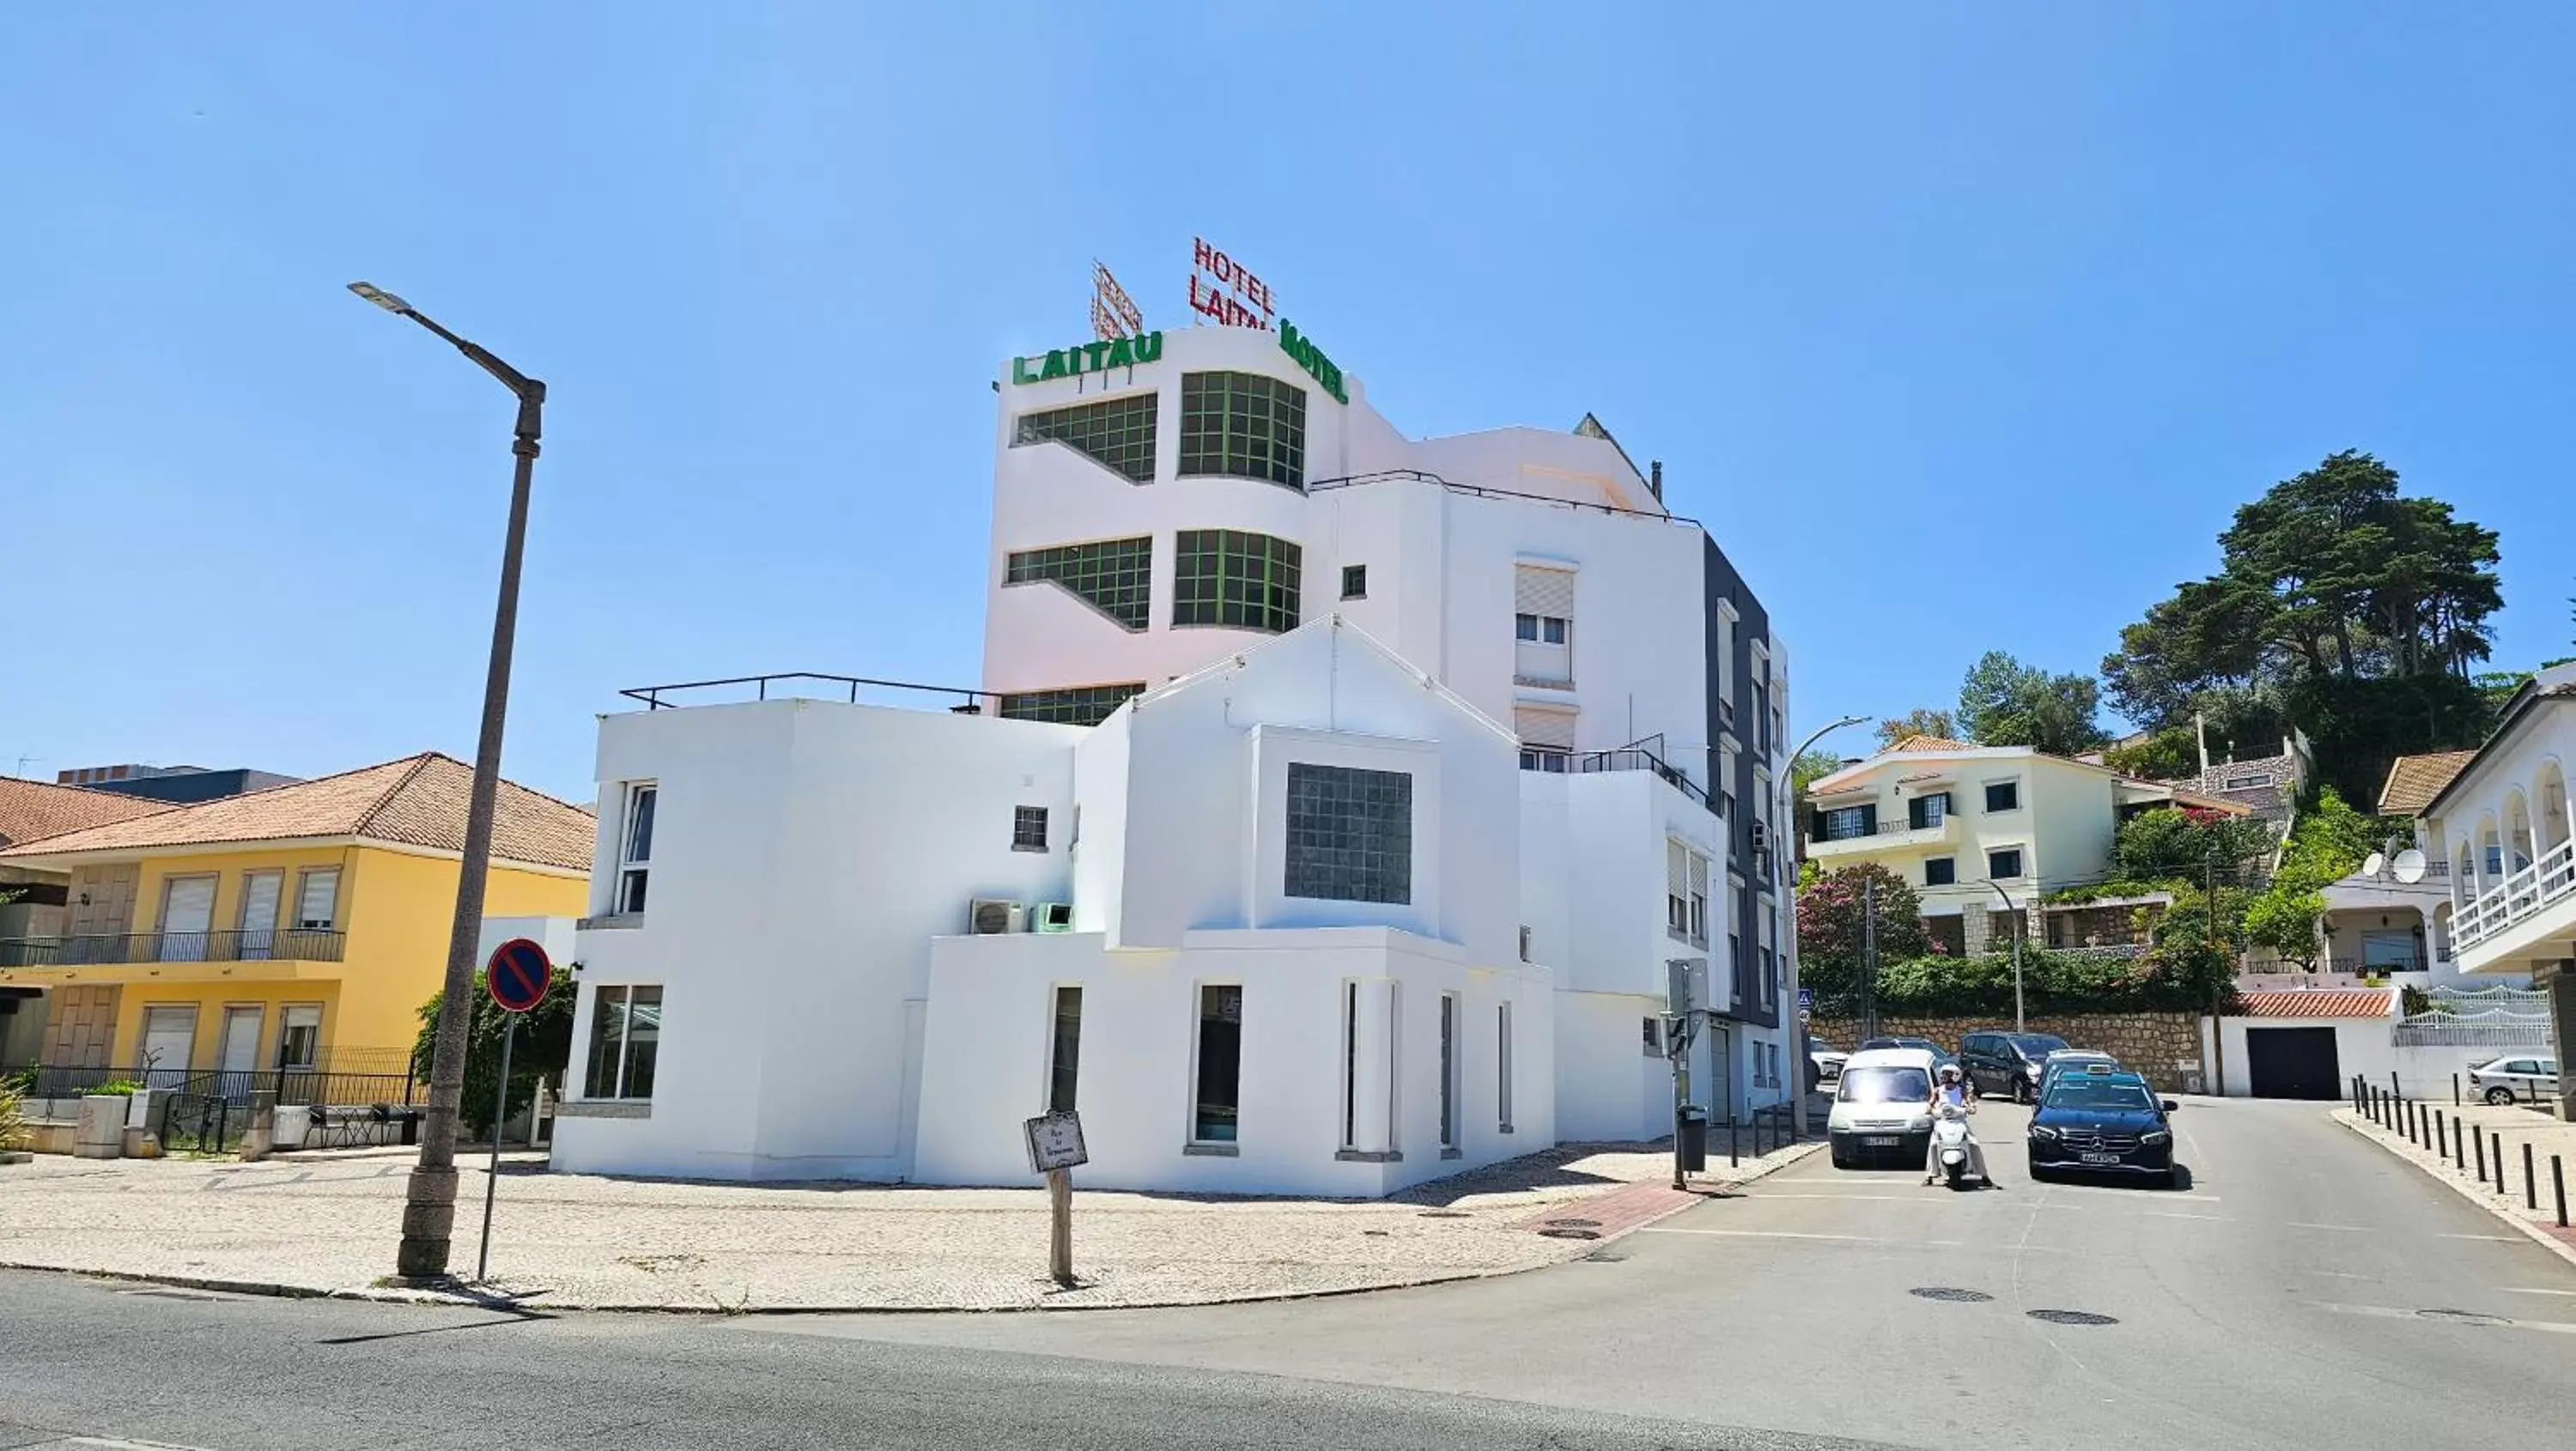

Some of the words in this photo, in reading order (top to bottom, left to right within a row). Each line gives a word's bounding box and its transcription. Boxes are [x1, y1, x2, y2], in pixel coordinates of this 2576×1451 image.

[1194, 237, 1275, 316] HOTEL
[1013, 331, 1163, 386] LAITAU
[1279, 318, 1349, 404] HOTEL
